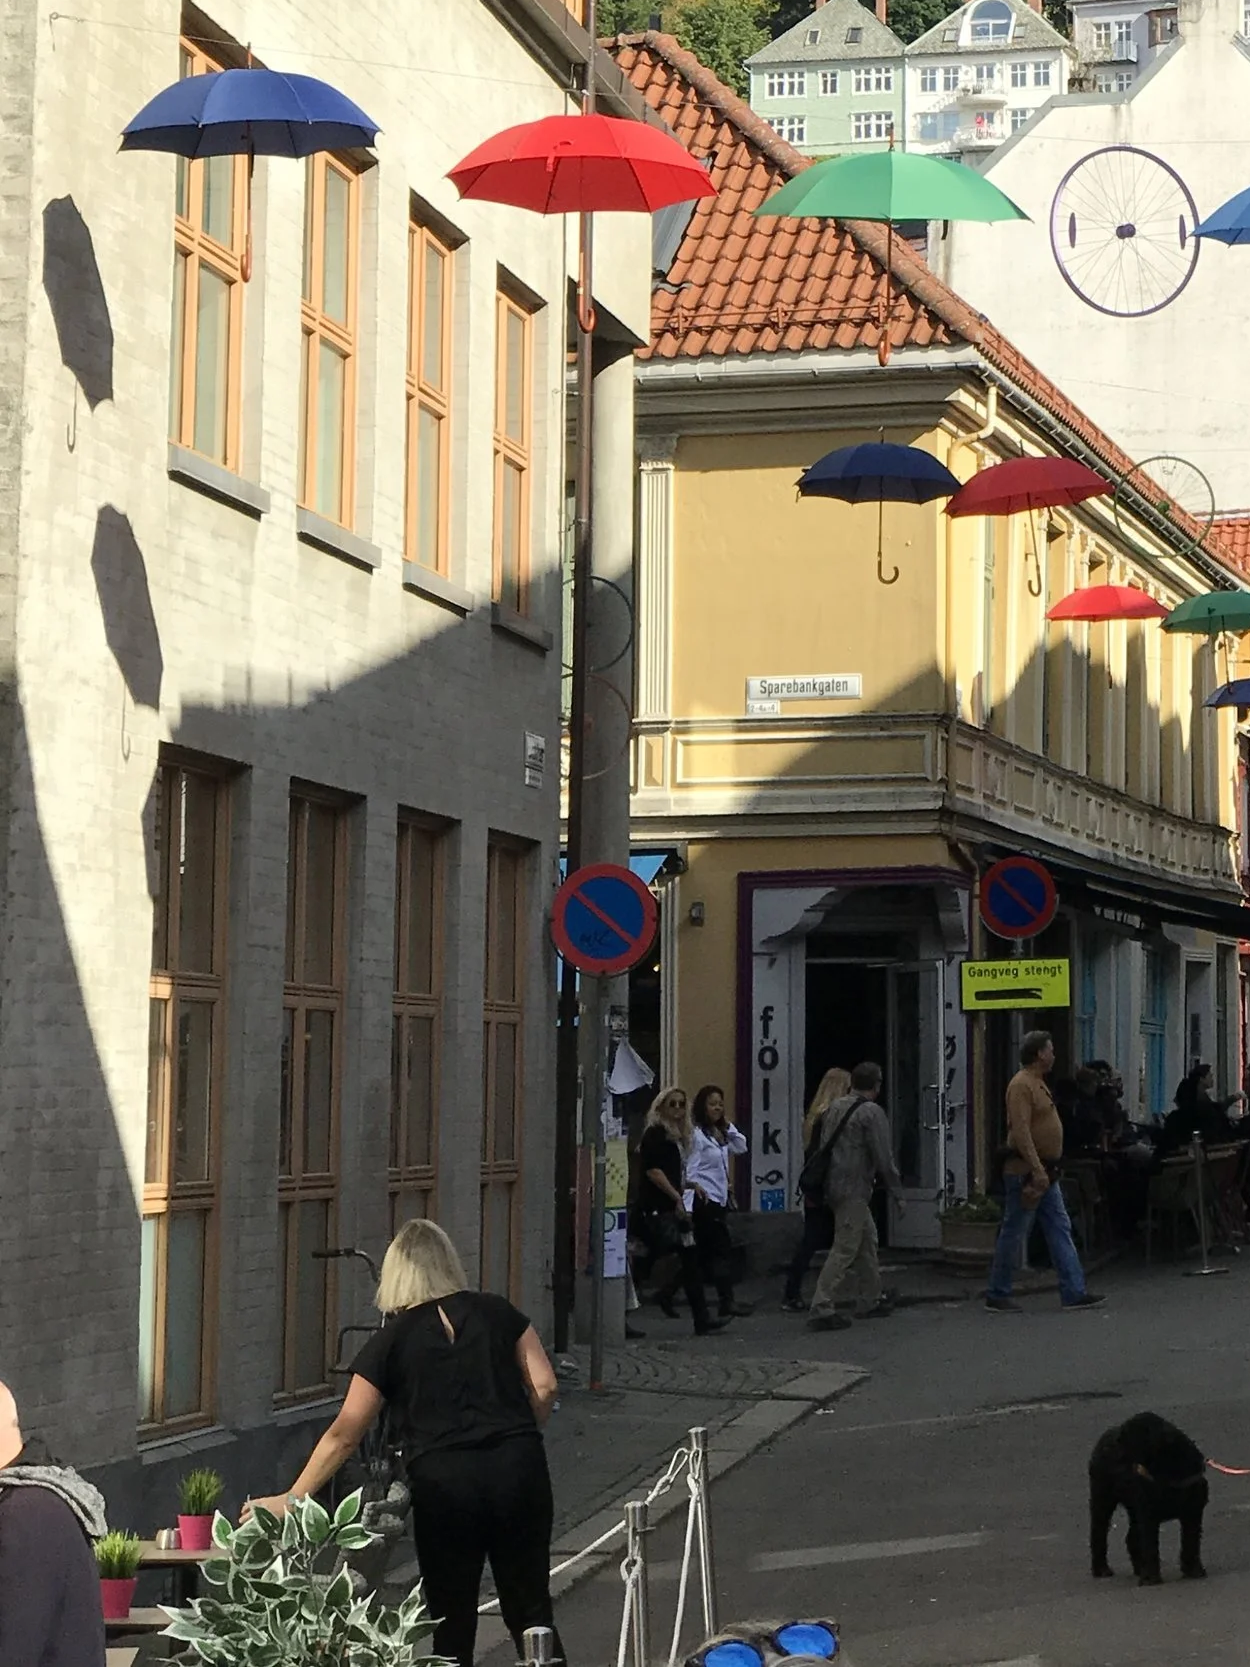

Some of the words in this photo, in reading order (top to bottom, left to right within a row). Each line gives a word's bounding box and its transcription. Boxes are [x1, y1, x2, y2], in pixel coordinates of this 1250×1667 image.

[760, 679, 848, 696] Sparebankgaten
[968, 965, 1019, 980] Gangveg
[1024, 964, 1062, 978] stengt
